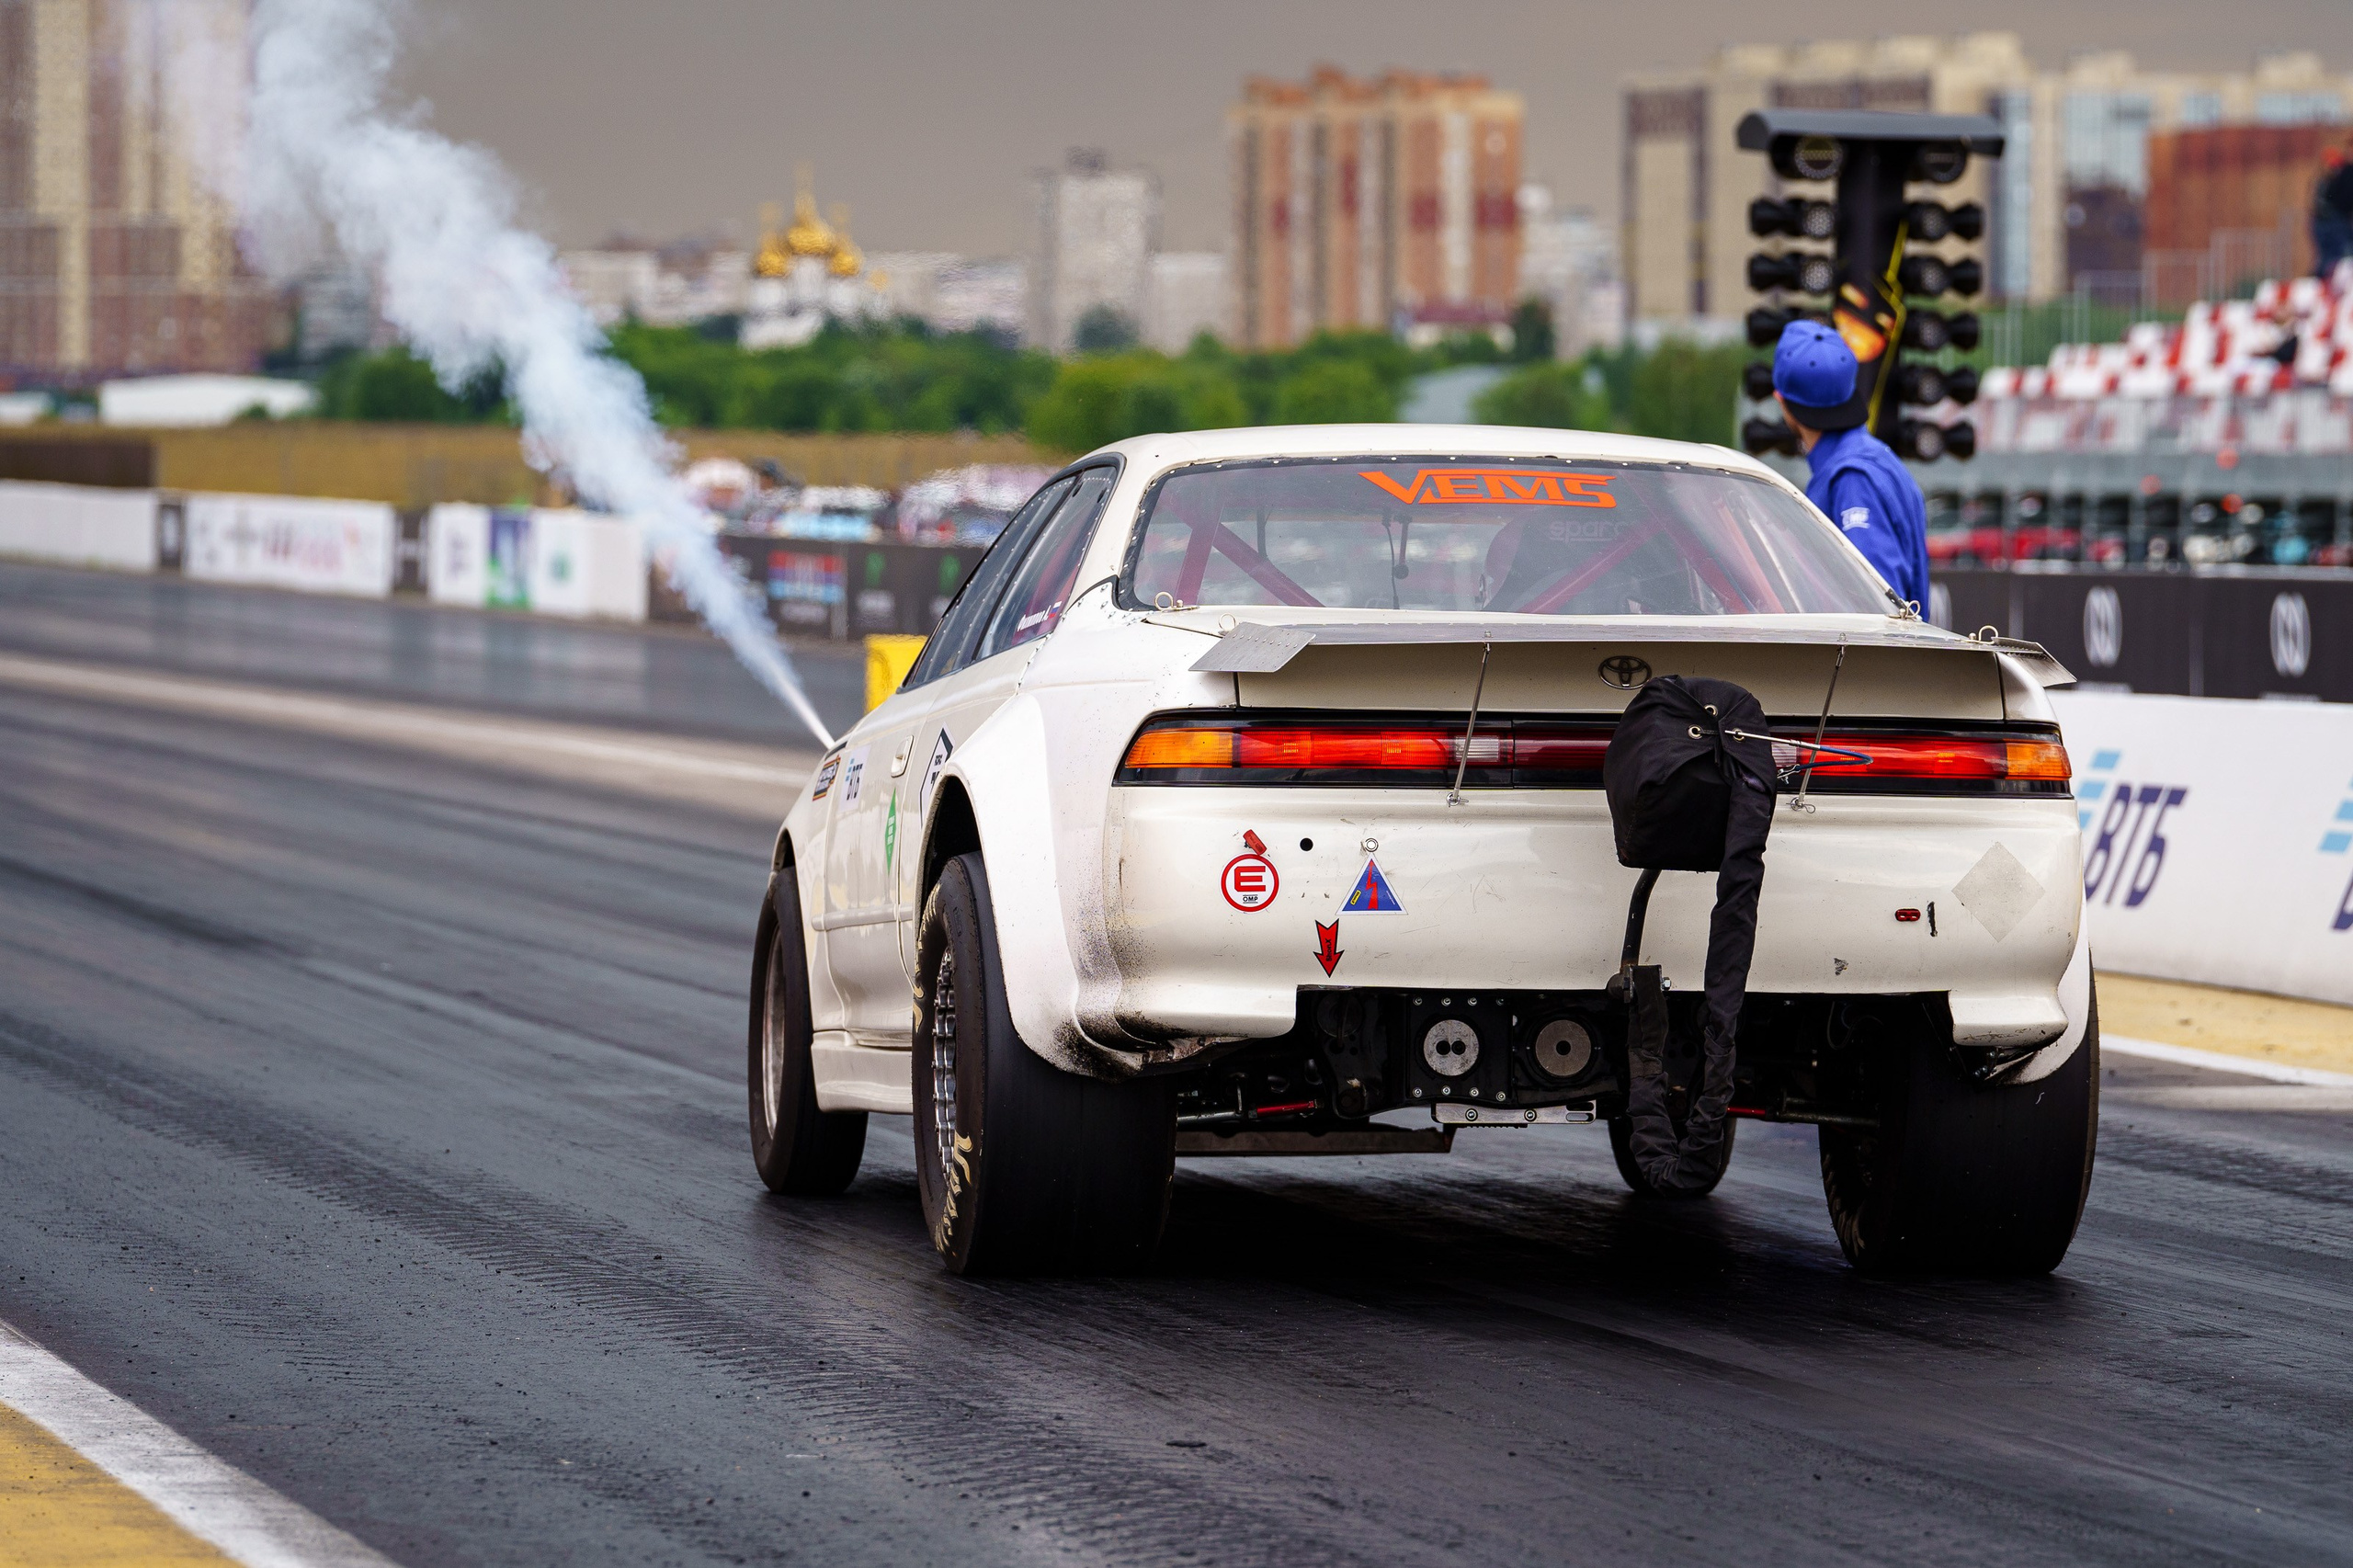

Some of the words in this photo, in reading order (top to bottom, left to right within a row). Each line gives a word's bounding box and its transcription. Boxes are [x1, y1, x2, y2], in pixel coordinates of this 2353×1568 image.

[1358, 469, 1617, 508] VEMS
[2083, 784, 2188, 906] ВТБ
[1234, 865, 1266, 892] E
